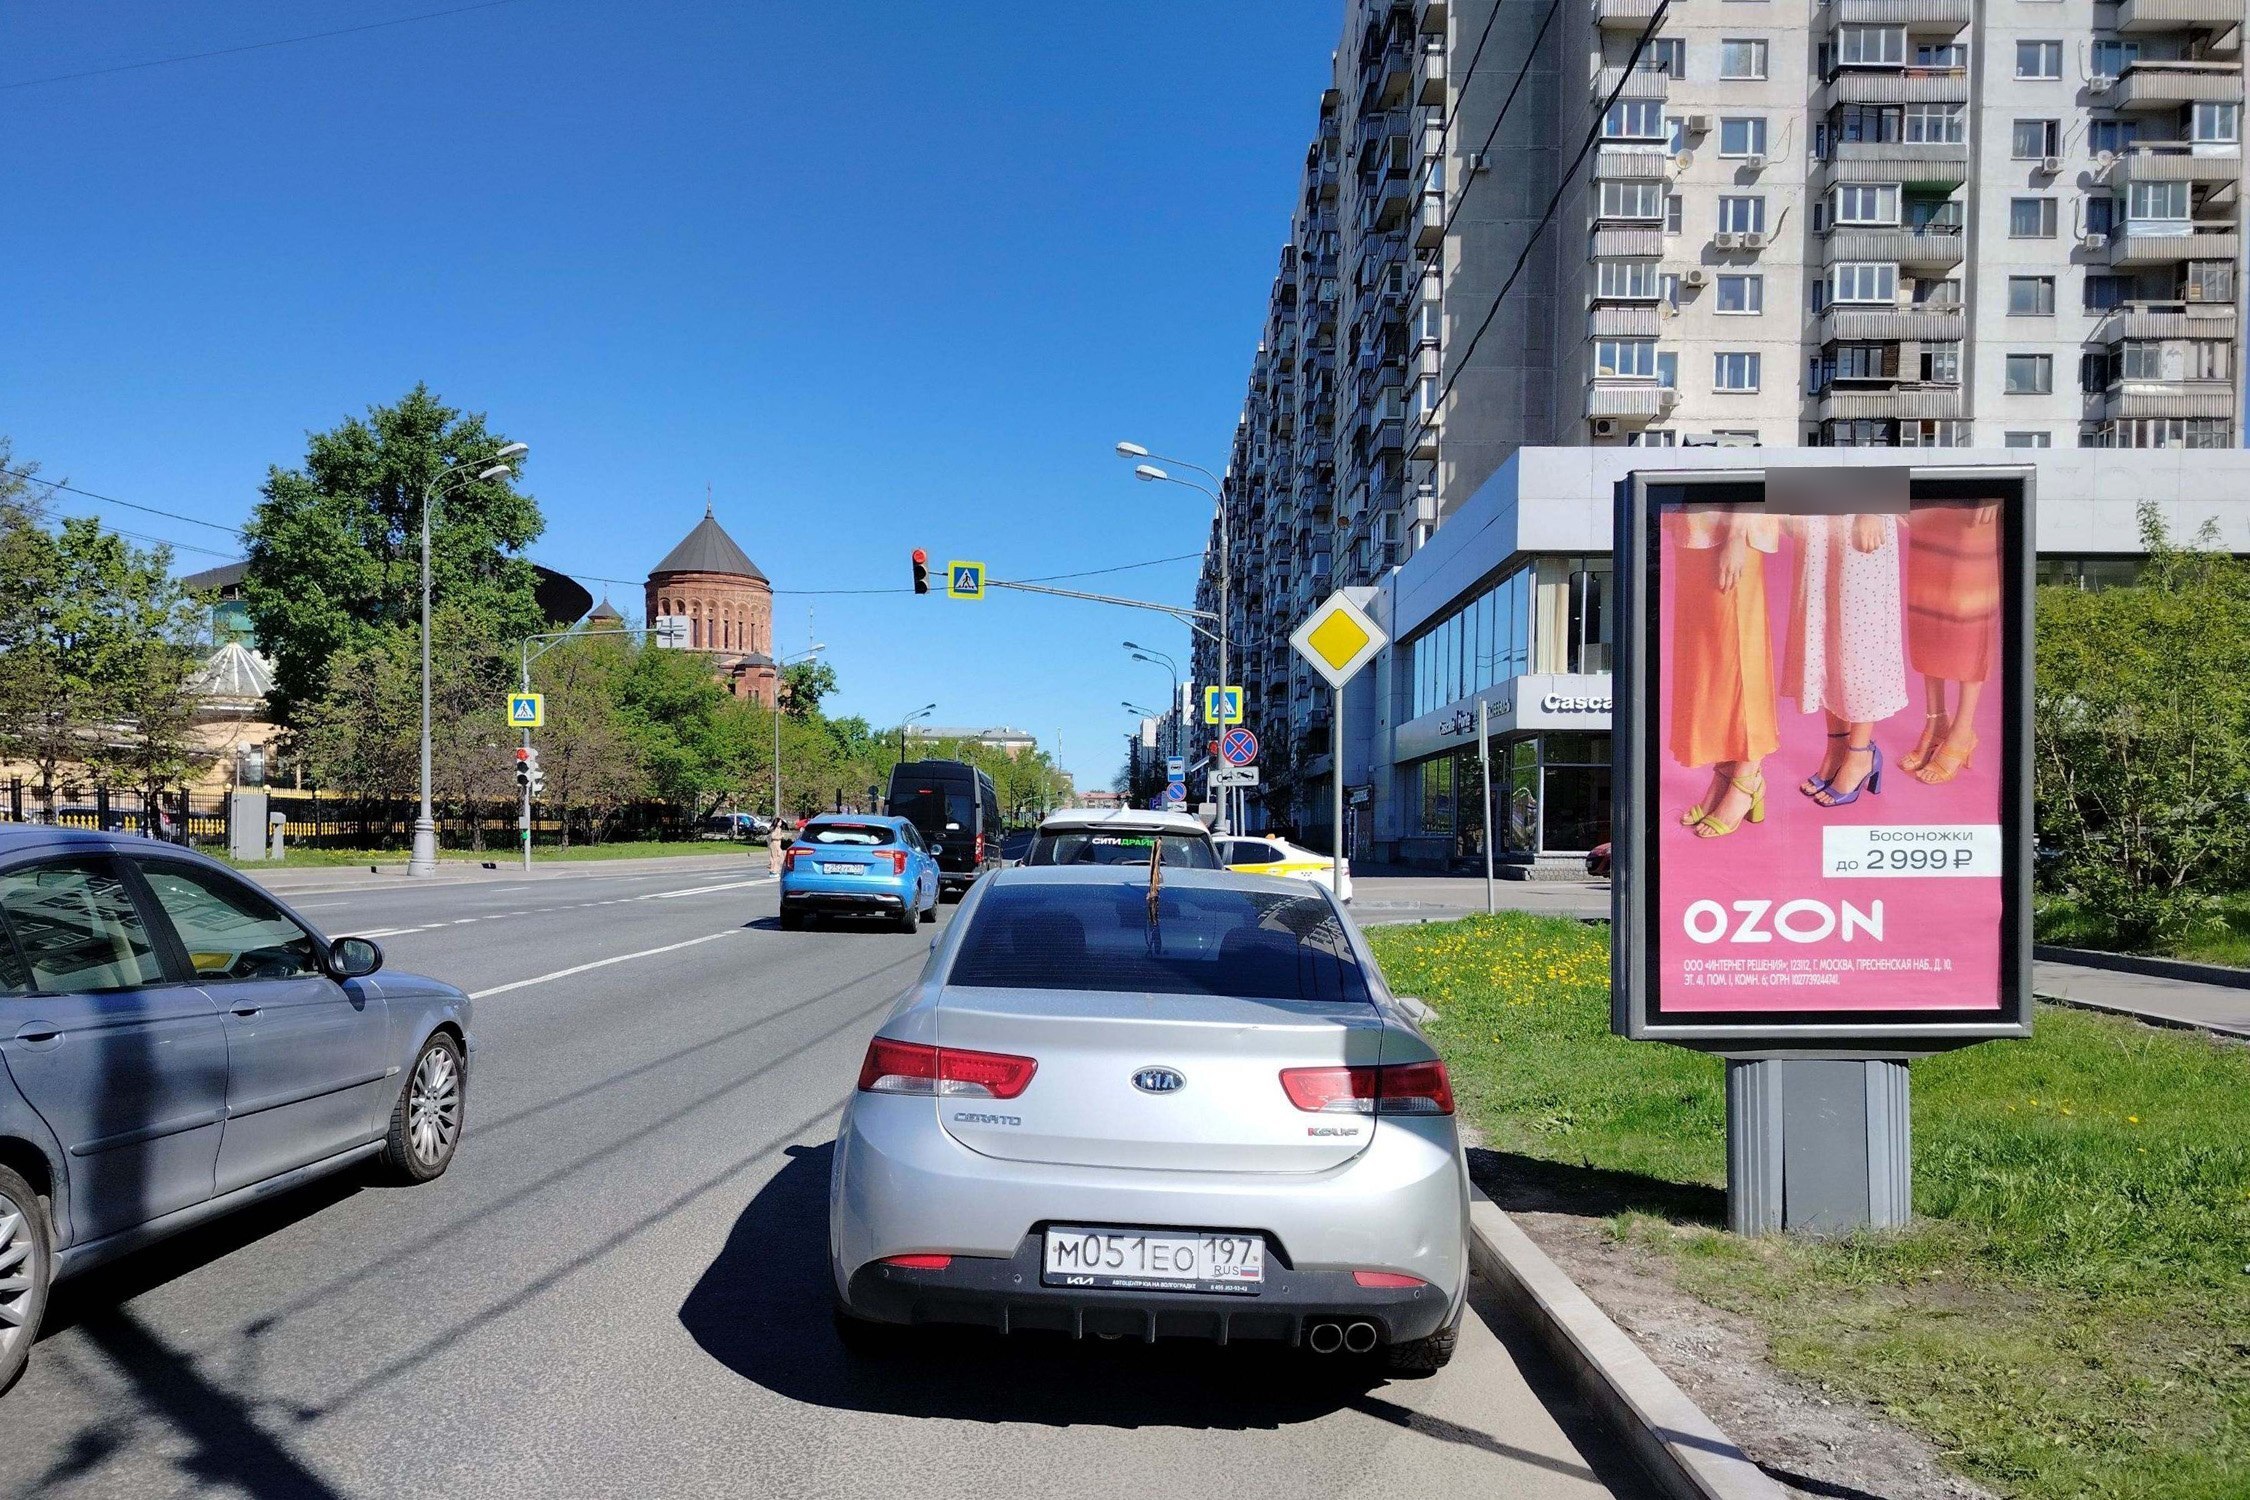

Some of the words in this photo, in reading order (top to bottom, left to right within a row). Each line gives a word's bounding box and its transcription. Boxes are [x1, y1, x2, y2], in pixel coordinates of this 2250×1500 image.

[1869, 830, 1974, 842] Босоножки
[1836, 859, 1859, 871] до
[1683, 898, 1884, 944] OZON
[1683, 959, 1704, 971] ООО
[1819, 959, 1855, 972] МОСКВА,
[1856, 959, 1911, 970] ПРЕСНЕНСКАЯ
[1706, 973, 1727, 986] ПОМ.
[1735, 973, 1760, 986] КОМН.
[1770, 973, 1790, 986] ОГРН
[953, 1112, 1022, 1126] CERATO
[1213, 1264, 1240, 1277] RUS
